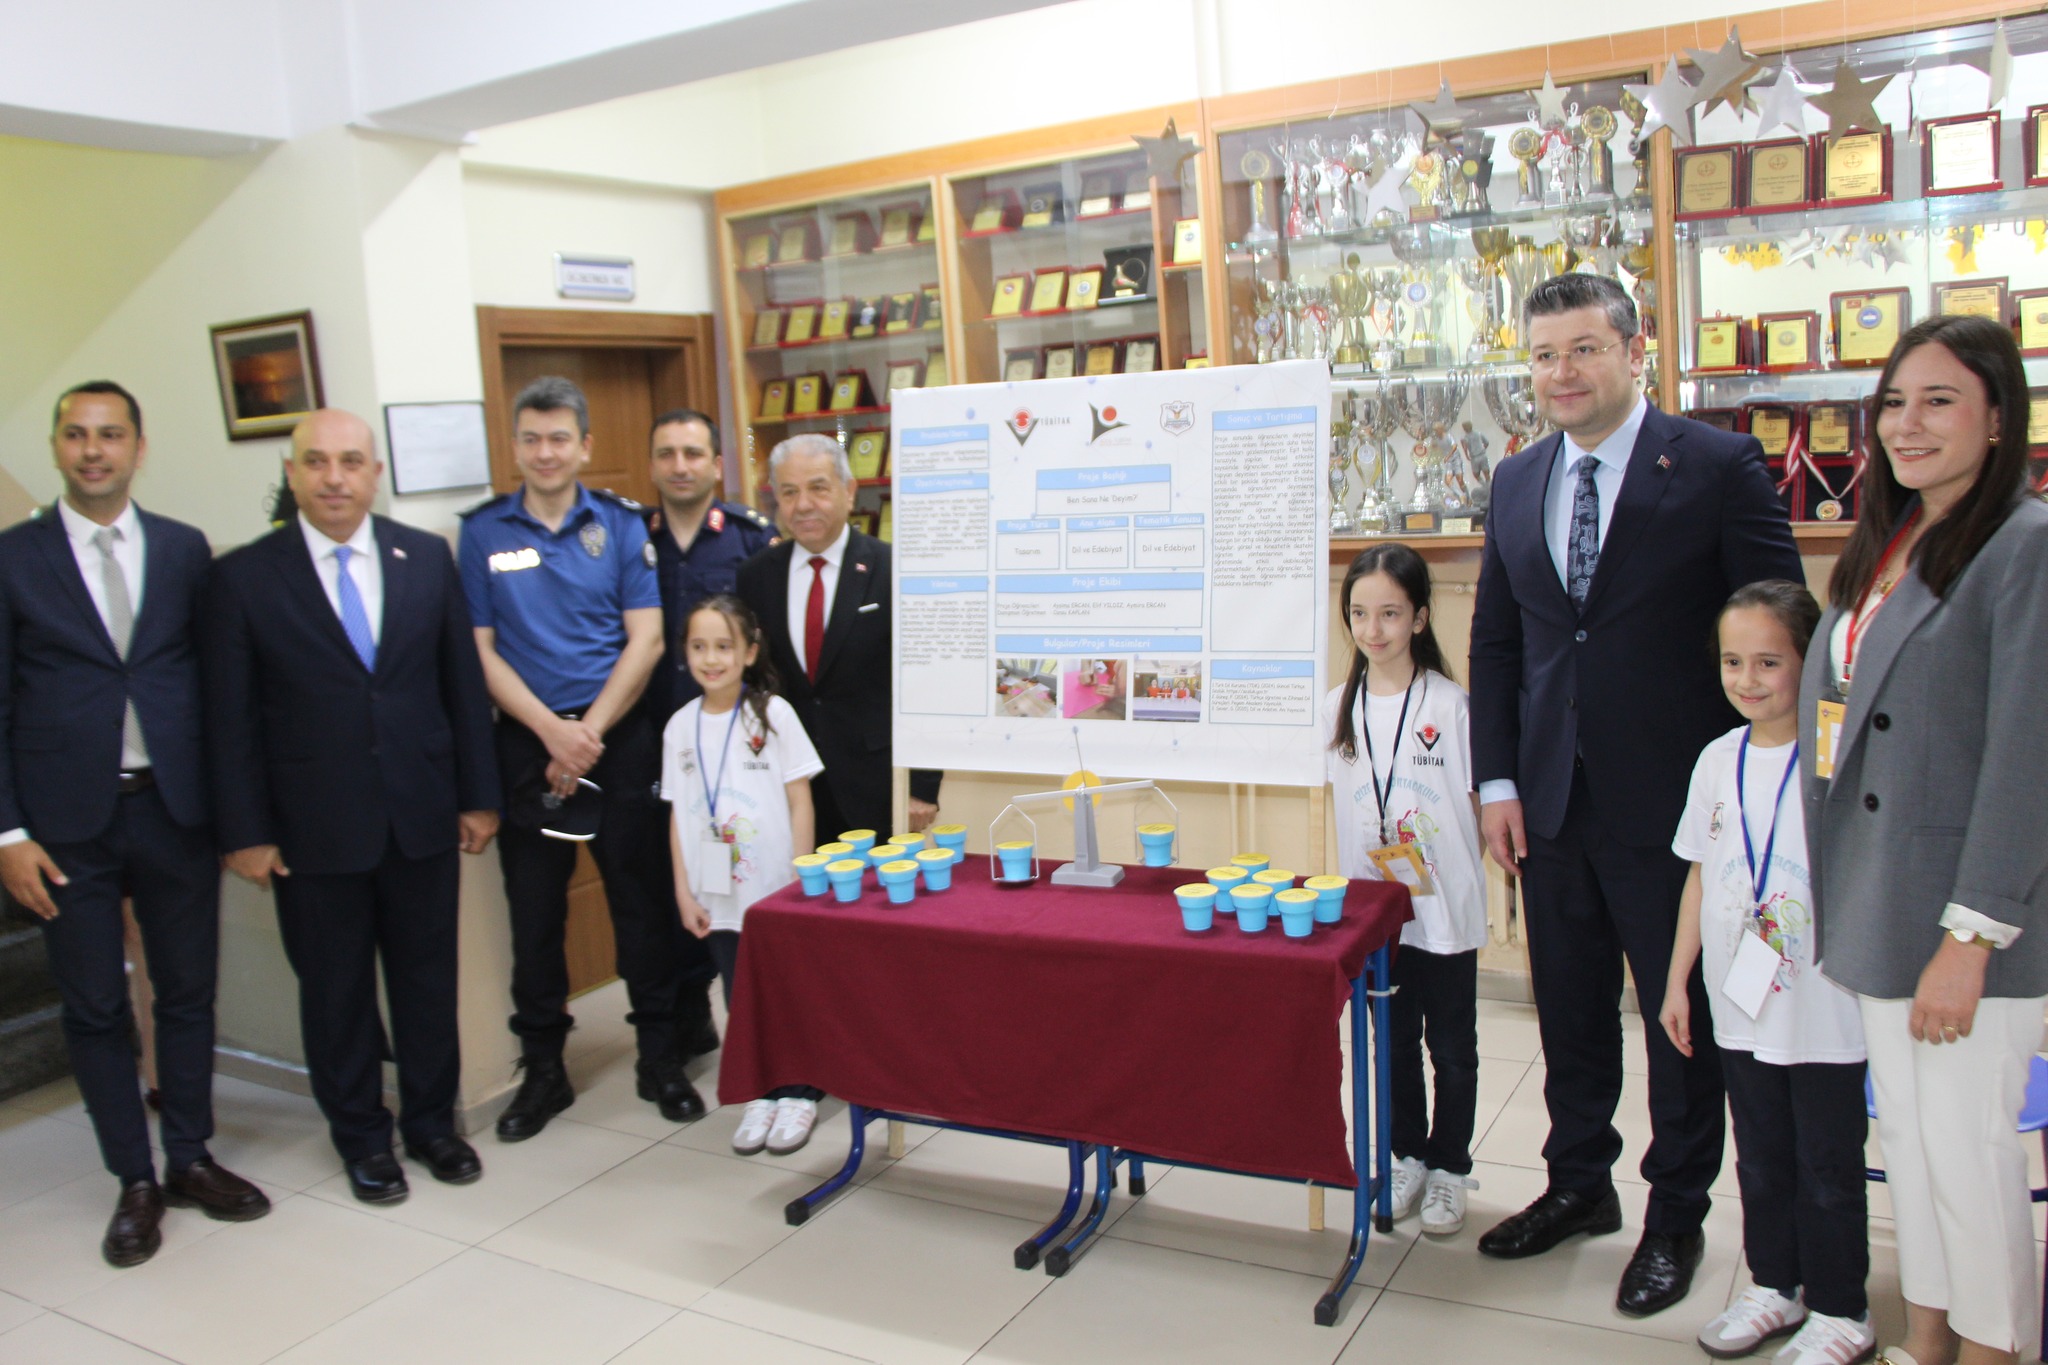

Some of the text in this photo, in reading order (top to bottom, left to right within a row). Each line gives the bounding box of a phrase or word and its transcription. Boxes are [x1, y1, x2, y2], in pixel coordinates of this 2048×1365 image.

[1040, 416, 1070, 426] TÜBİTAK
[1067, 496, 1080, 504] Ben
[1138, 515, 1201, 525] Tematik Konusu
[1072, 546, 1082, 554] Dil
[1092, 546, 1122, 555] Edebiyat
[1142, 544, 1152, 552] Dil
[1164, 544, 1196, 554] Edebiyat
[1072, 576, 1121, 587] Proje Ekibi
[1044, 638, 1151, 649] Bulgular/Proje Resimleri
[1242, 664, 1282, 674] Kaynaklar
[1412, 754, 1444, 767] TÜBİTAK
